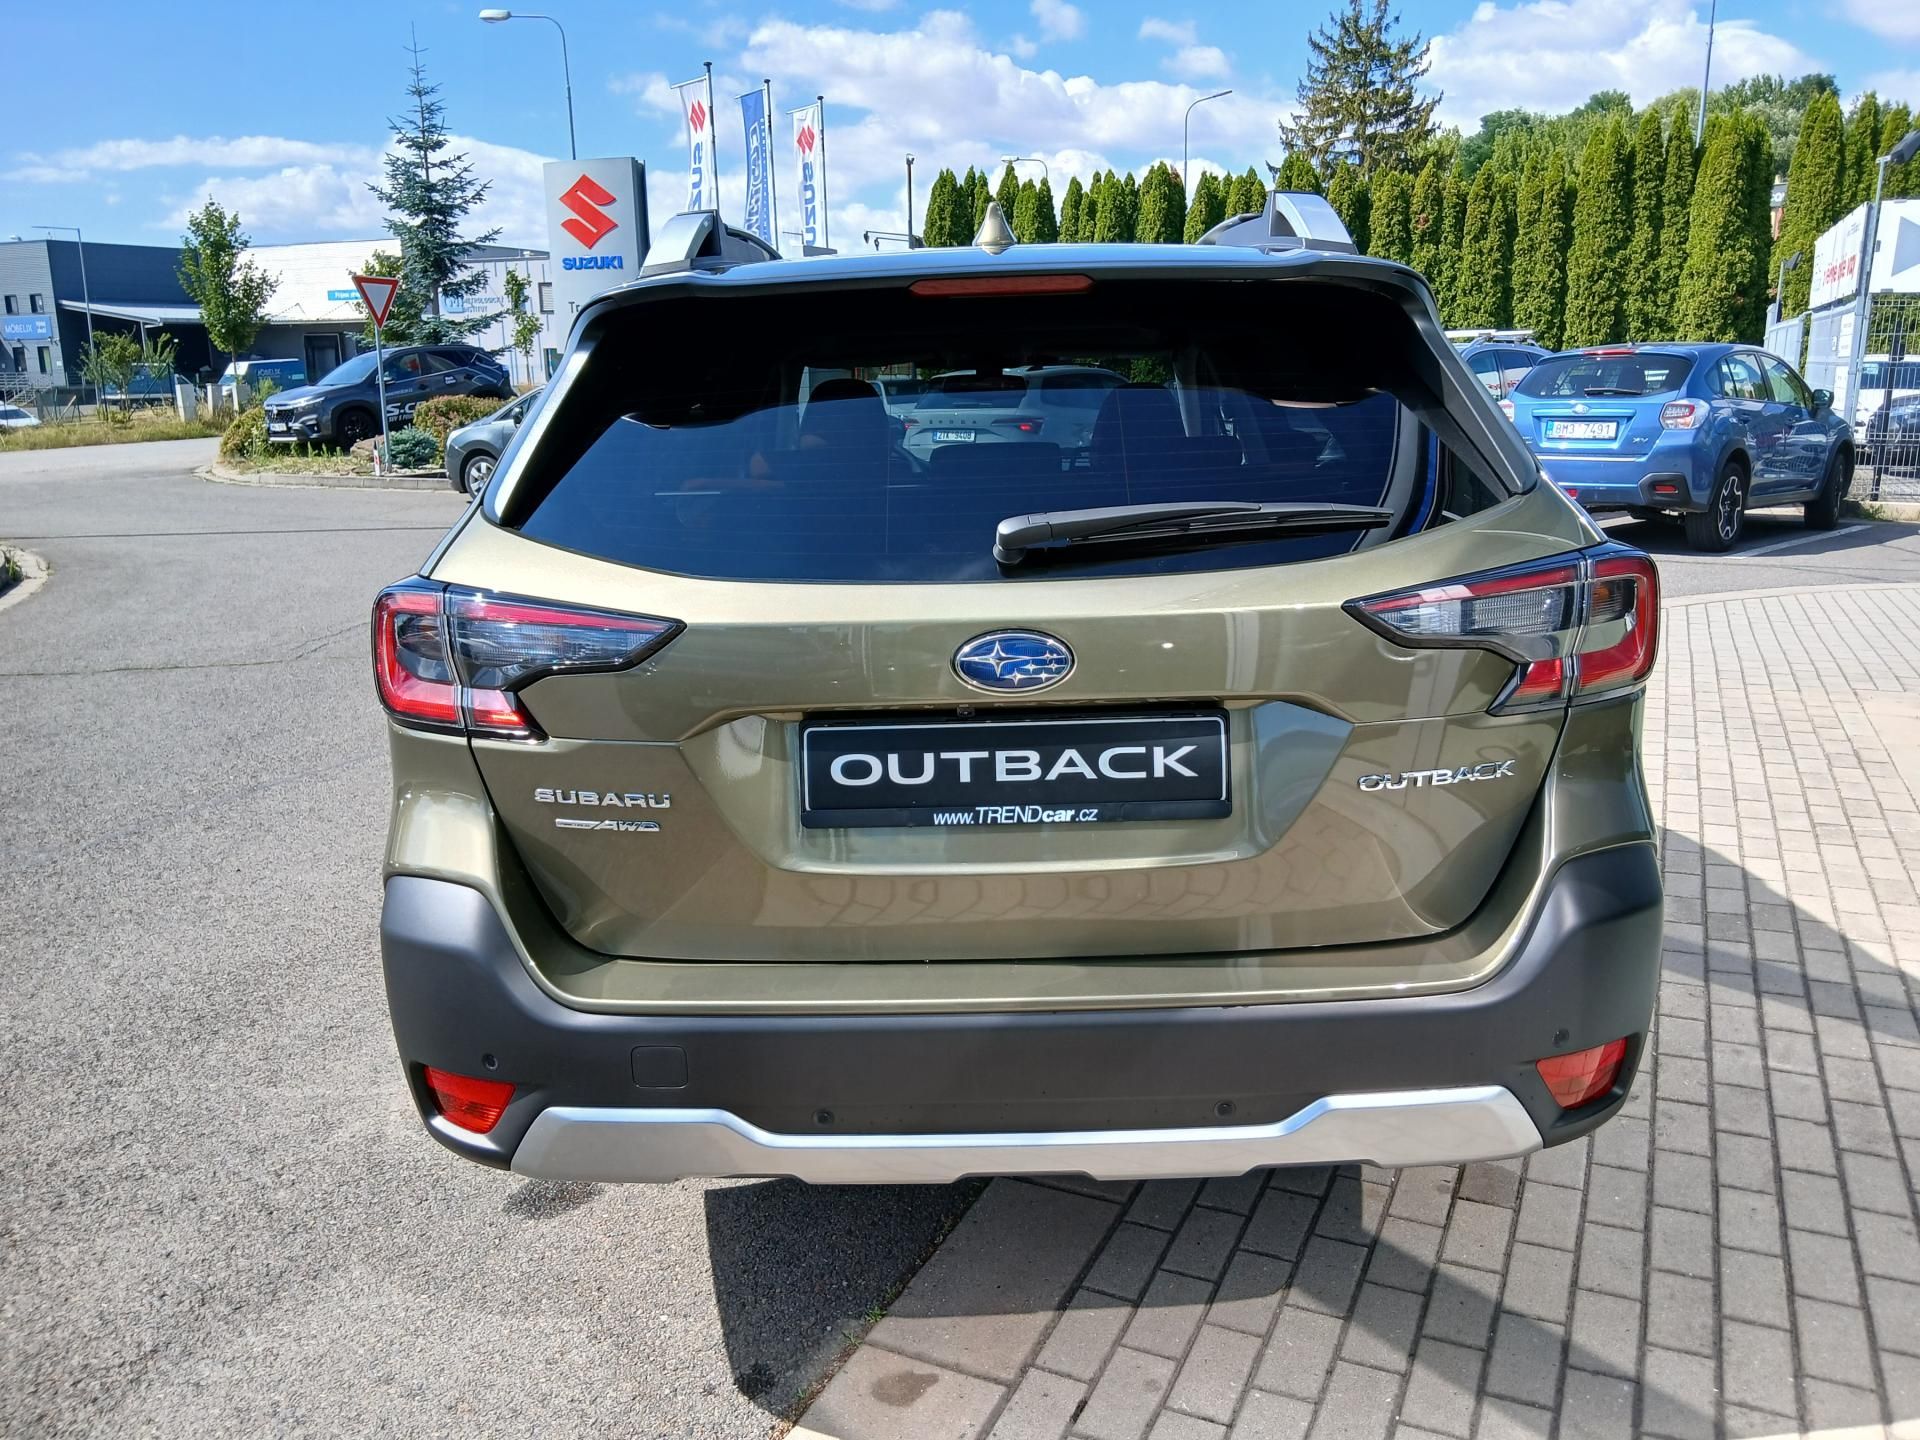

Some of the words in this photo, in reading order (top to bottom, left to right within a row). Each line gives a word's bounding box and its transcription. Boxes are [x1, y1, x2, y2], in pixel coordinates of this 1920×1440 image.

[562, 255, 624, 271] SUZUKI
[1584, 424, 1610, 435] 7491
[829, 744, 1199, 784] OUTBACK
[1358, 759, 1516, 792] OUTBACK
[534, 787, 671, 809] SUBARU
[933, 805, 1099, 825] www.TRENDcar.cz
[594, 820, 660, 832] AWD
